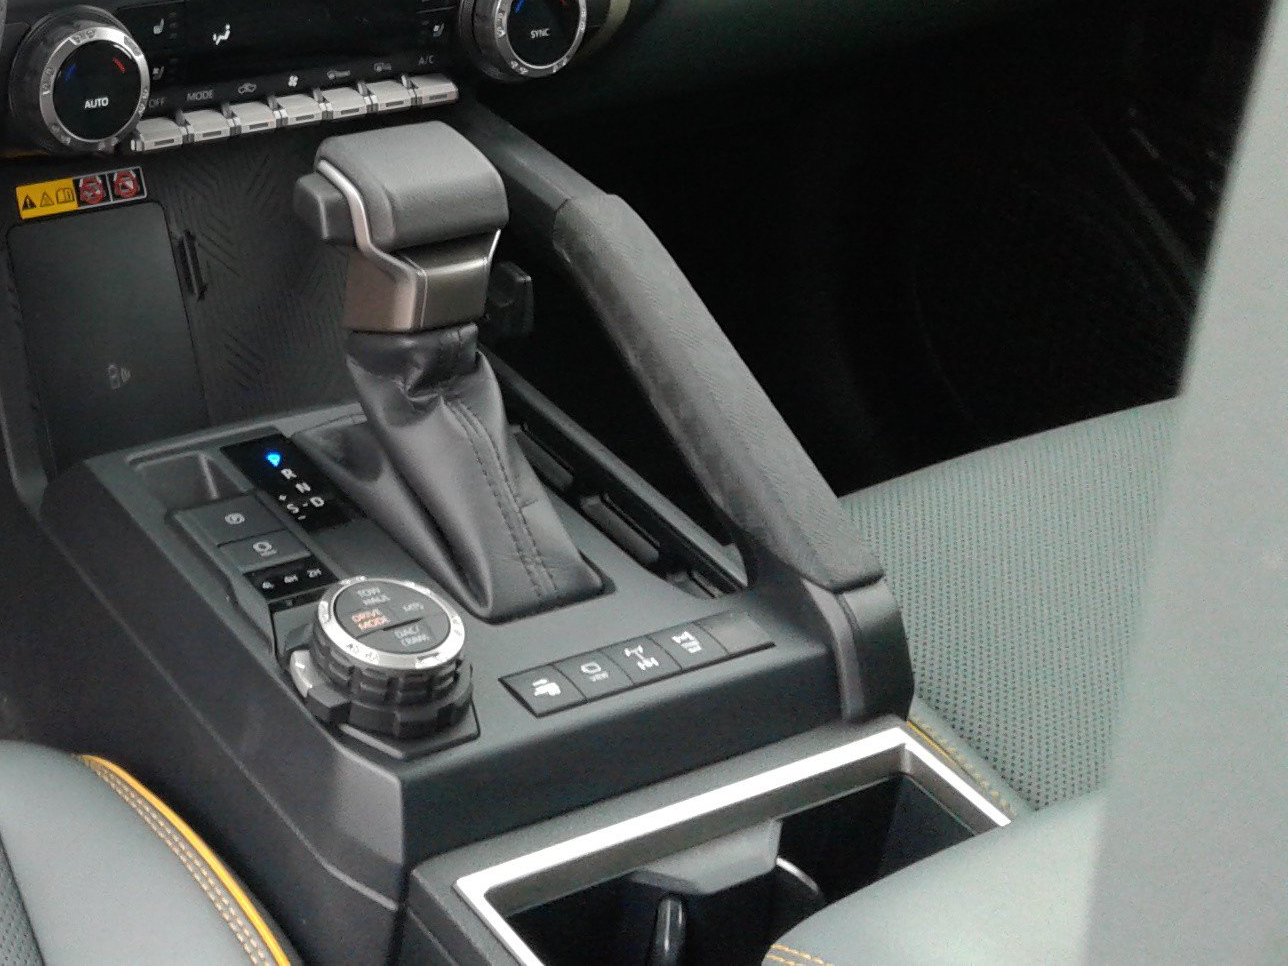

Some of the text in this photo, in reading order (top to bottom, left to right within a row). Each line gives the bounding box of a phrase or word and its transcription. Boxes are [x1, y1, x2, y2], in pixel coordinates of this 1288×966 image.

[530, 27, 551, 39] SYNC
[418, 54, 435, 66] A/C
[186, 89, 214, 102] MODE
[84, 96, 109, 110] AUTO
